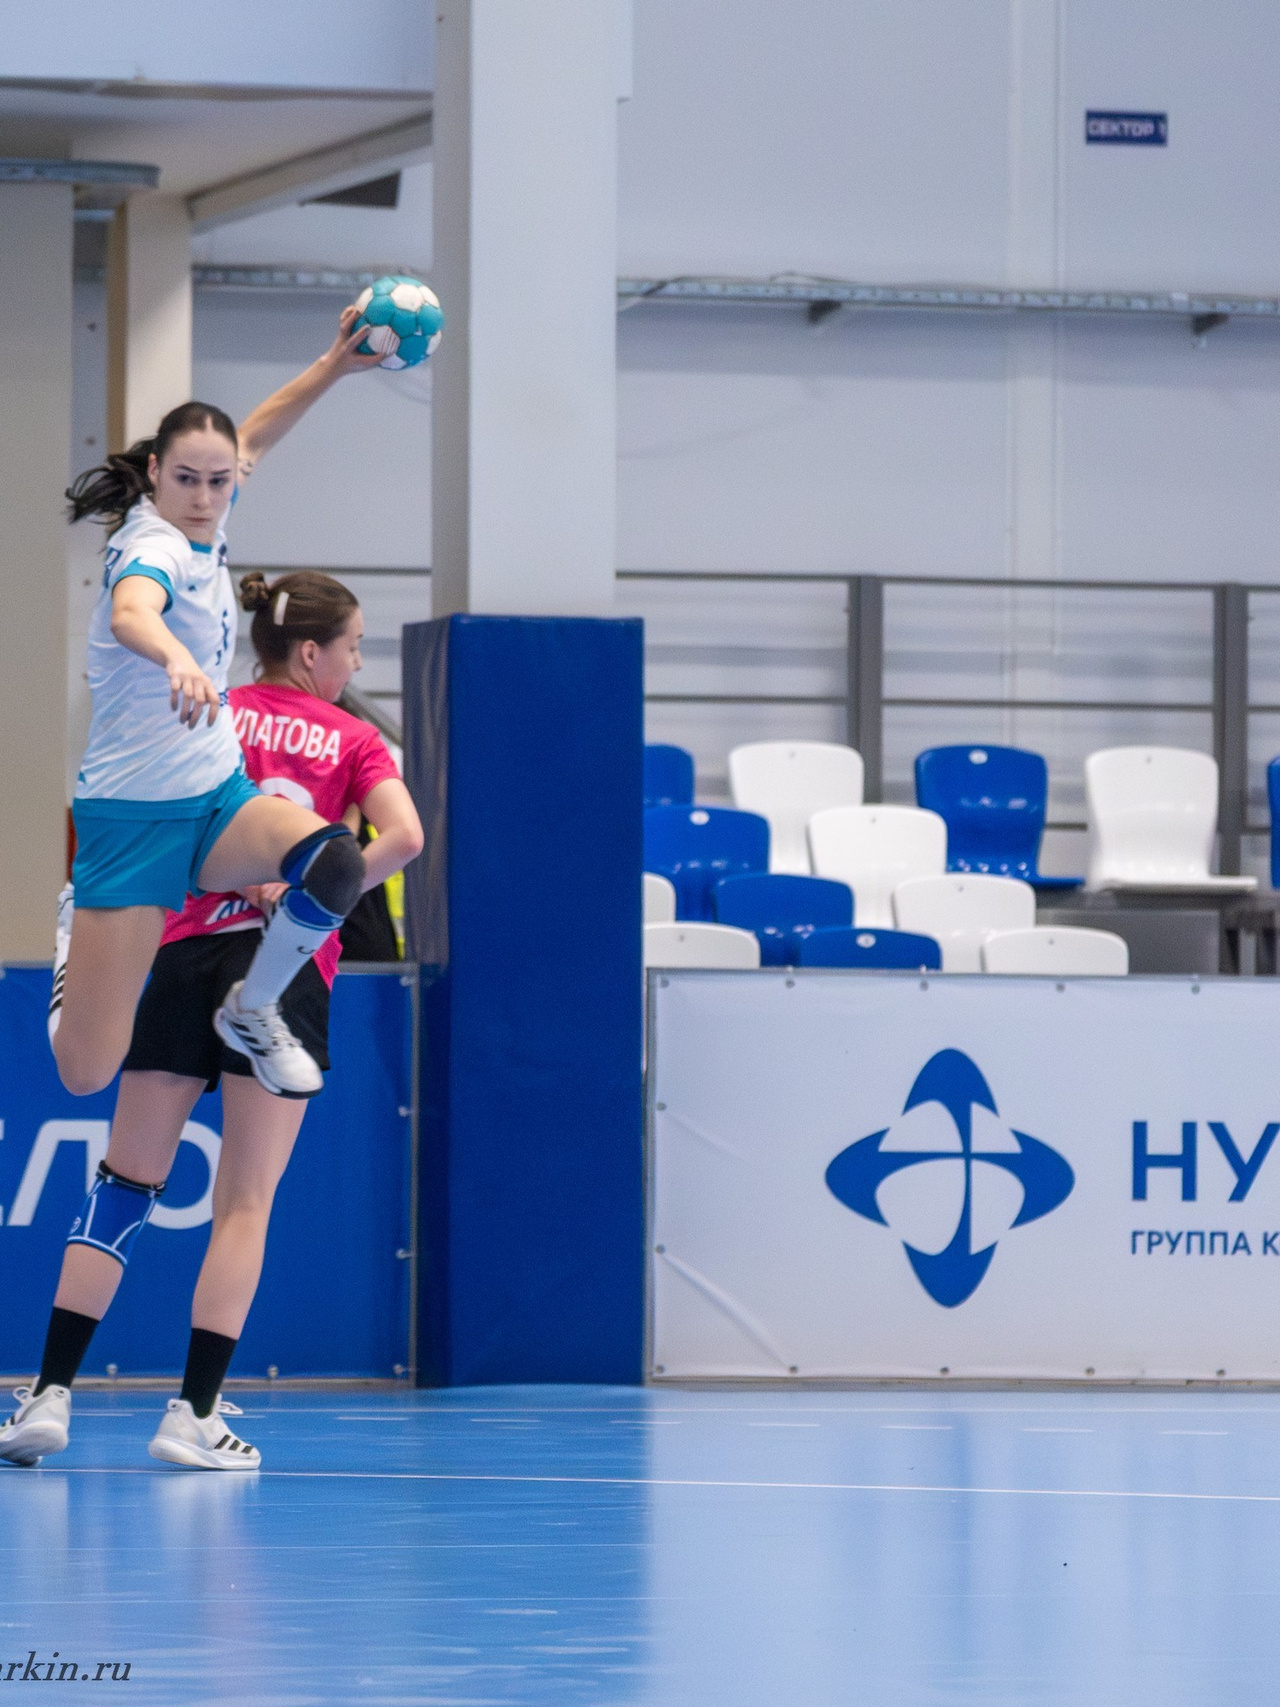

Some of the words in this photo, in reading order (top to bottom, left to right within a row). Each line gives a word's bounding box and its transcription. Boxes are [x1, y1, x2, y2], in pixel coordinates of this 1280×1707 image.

[1087, 118, 1155, 138] СЕКТОР
[1131, 1120, 1280, 1202] НУ
[1130, 1230, 1253, 1256] ГРУППА
